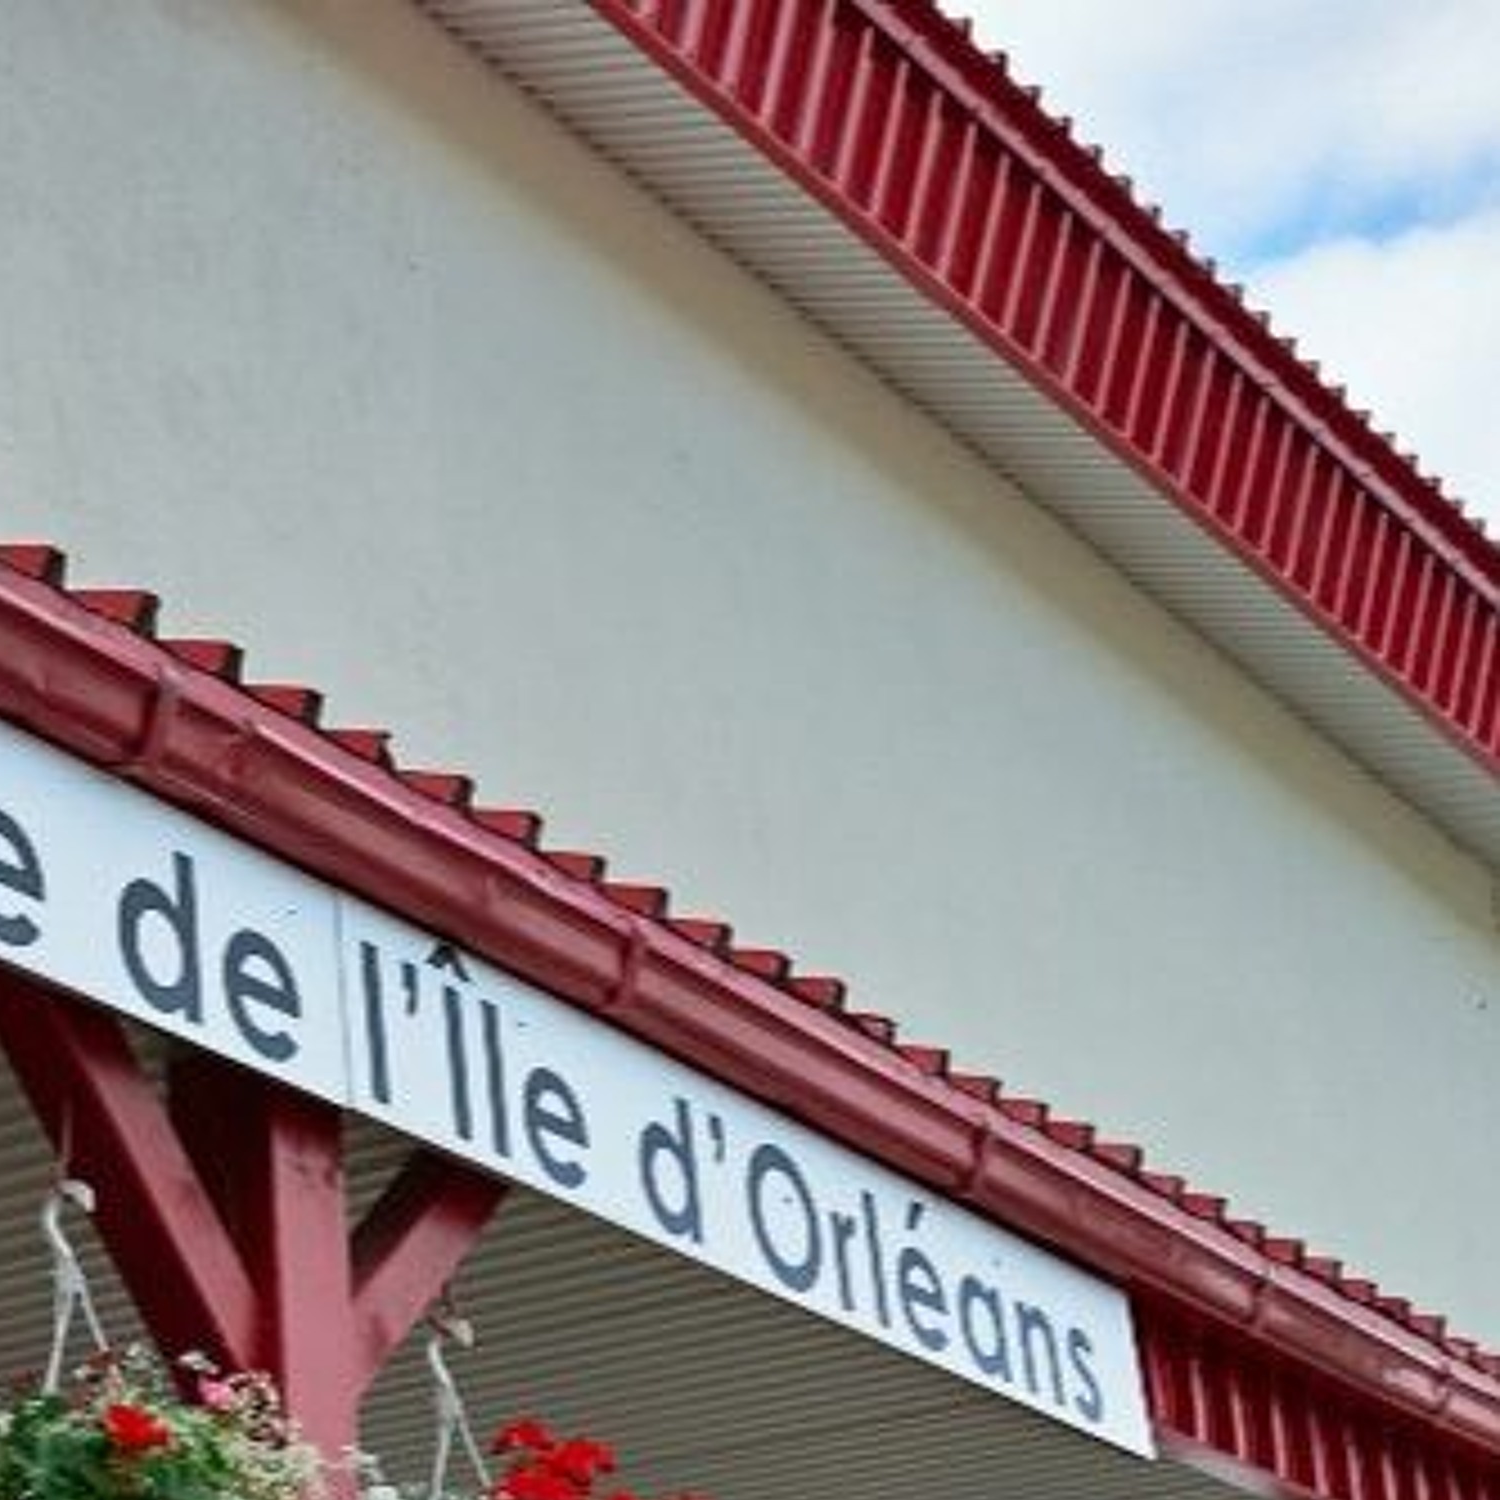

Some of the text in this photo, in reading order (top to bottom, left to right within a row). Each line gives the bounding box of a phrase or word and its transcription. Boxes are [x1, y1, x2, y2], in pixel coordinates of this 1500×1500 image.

[118, 851, 301, 1062] de
[361, 940, 589, 1190] l'Île
[639, 1097, 1102, 1423] d'Orléans
